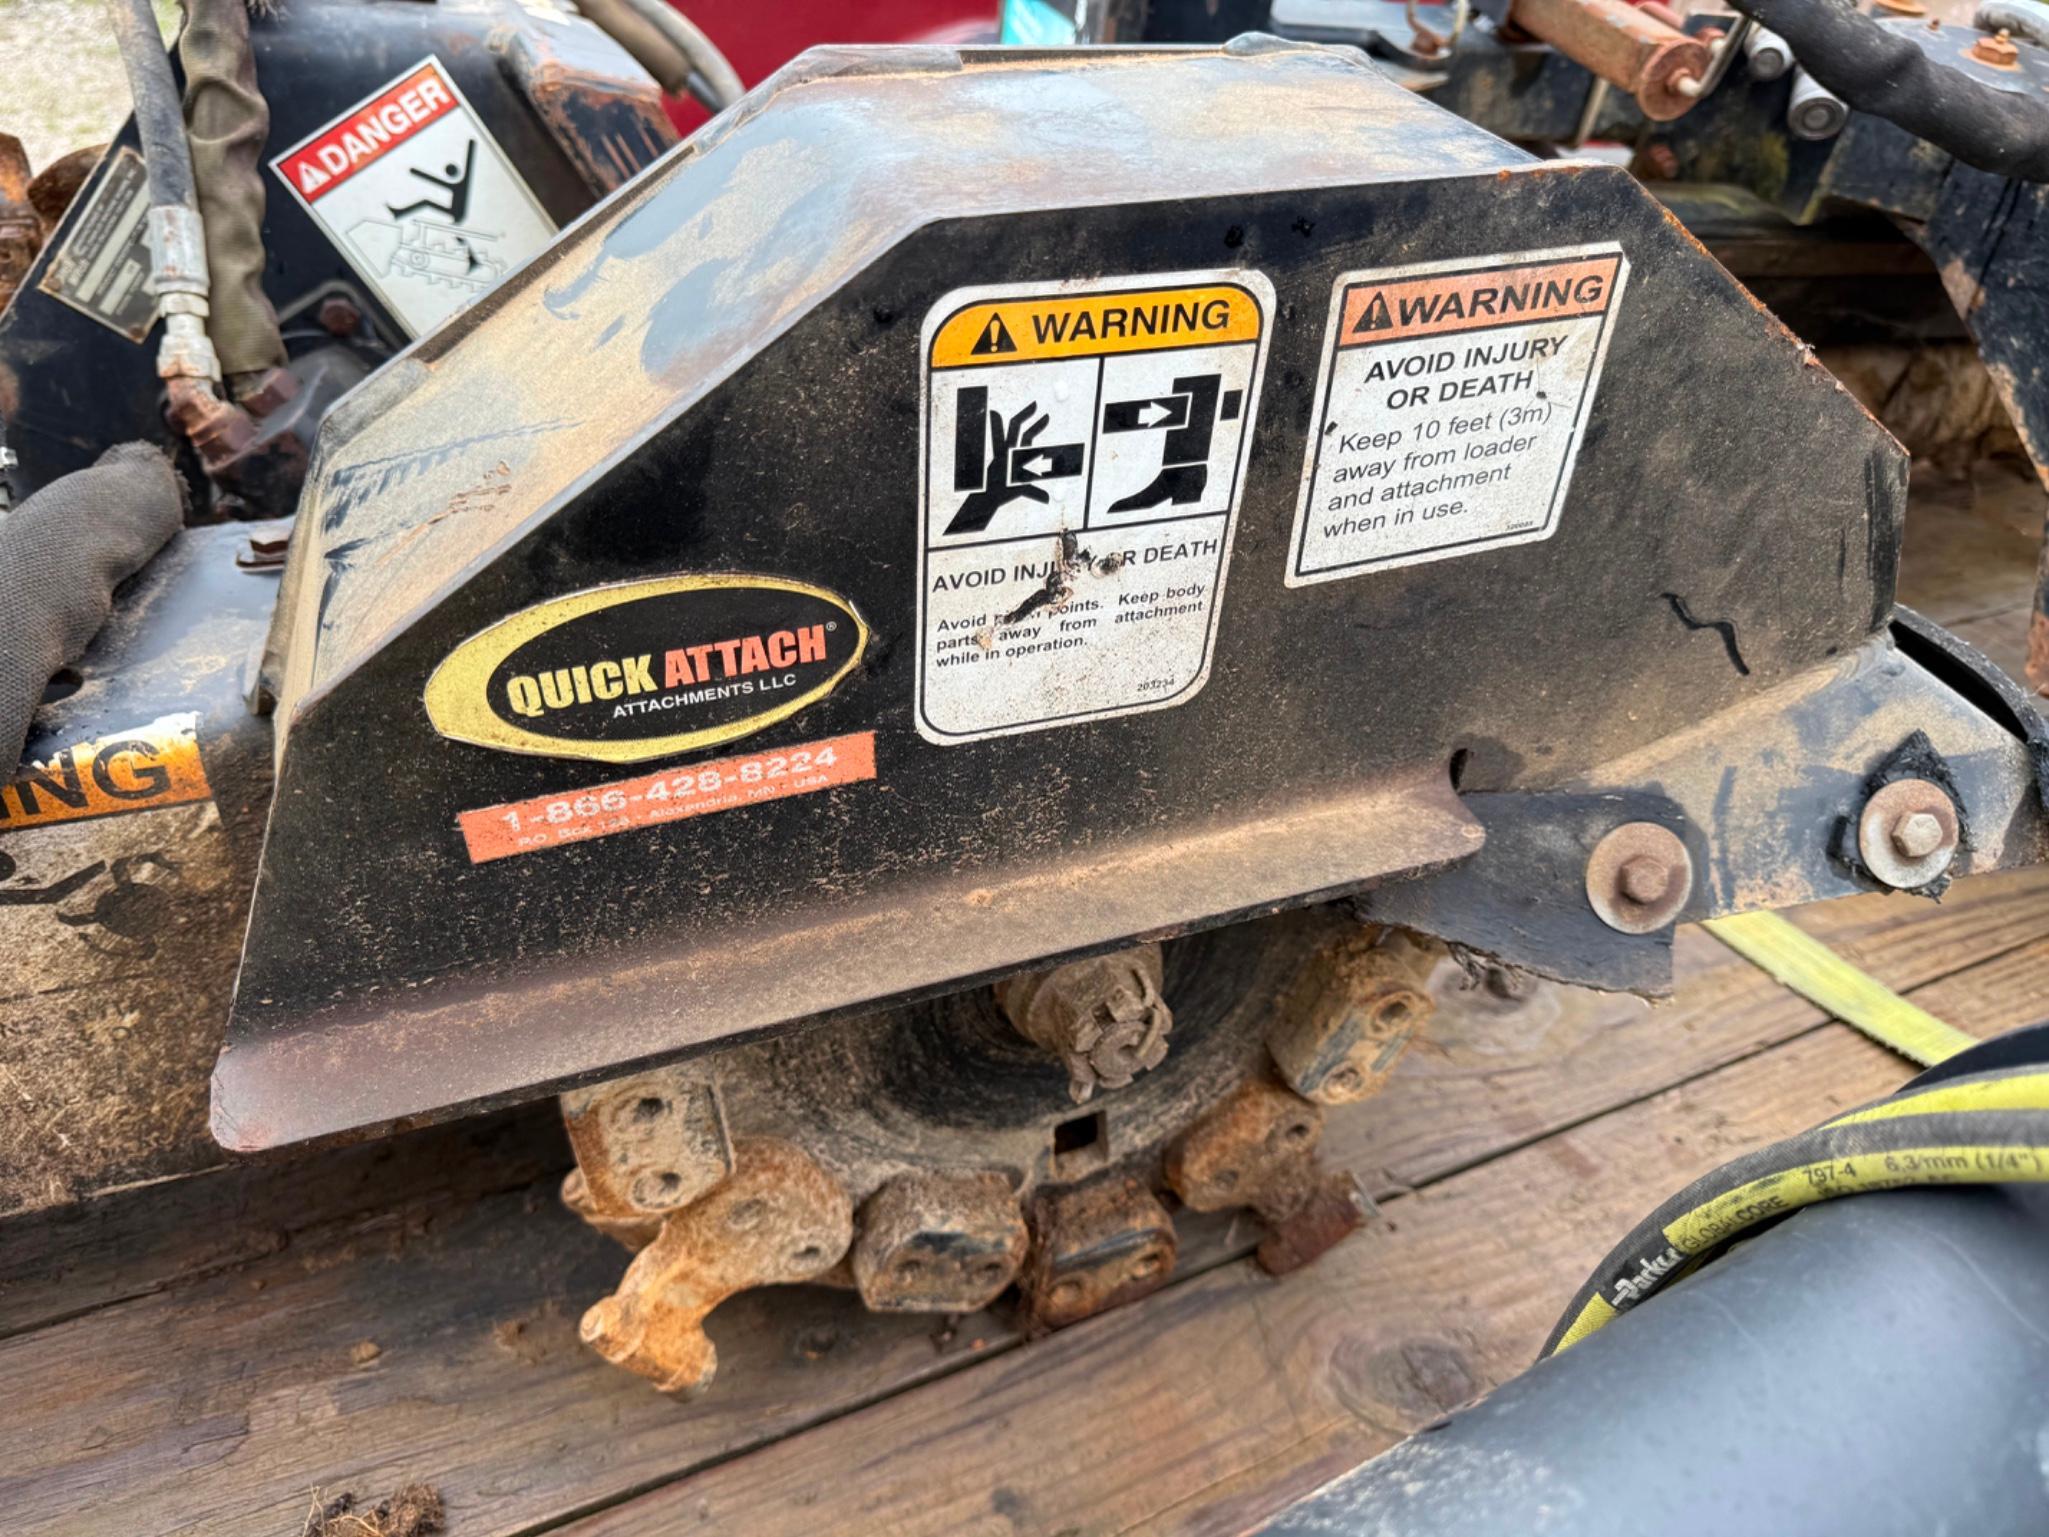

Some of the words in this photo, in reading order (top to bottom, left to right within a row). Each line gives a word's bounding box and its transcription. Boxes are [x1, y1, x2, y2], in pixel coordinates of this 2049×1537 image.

[318, 78, 450, 174] DANGER
[1032, 300, 1230, 344] WARNING
[1398, 274, 1603, 327] WARNING
[1364, 352, 1454, 383] AVOID
[1463, 335, 1568, 368] INJURY
[1387, 386, 1429, 410] OR
[1439, 370, 1533, 402] DEATH
[1339, 429, 1403, 454] Keep
[1413, 420, 1441, 442] 10
[1448, 412, 1492, 436] feet
[1499, 402, 1552, 432] (3m)
[1333, 459, 1397, 484] away
[1403, 449, 1457, 472] from
[1464, 434, 1538, 461] loader
[1328, 487, 1374, 512] and
[1380, 463, 1512, 502] attachment
[1323, 515, 1386, 539] when
[1393, 508, 1415, 526] in
[1421, 501, 1469, 521] use.
[932, 567, 1006, 593] AVOID
[1144, 539, 1217, 564] DEATH
[937, 614, 987, 632] Avoid
[1118, 590, 1159, 606] Keep
[1166, 583, 1205, 600] body
[937, 635, 978, 653] parts
[1000, 627, 1041, 642] away
[1060, 618, 1097, 633] from
[1114, 601, 1203, 624] attachment
[936, 652, 979, 667] while
[985, 648, 1000, 661] in
[1005, 637, 1088, 658] operation.
[506, 654, 658, 718] QUICK
[613, 680, 754, 719] ATTACHMENTS
[759, 673, 797, 692] LLC
[502, 746, 838, 833] 1-866-428-8224
[793, 773, 829, 789] USA
[1802, 1162, 1857, 1185] 797-4
[1611, 1247, 1683, 1306] Parker
